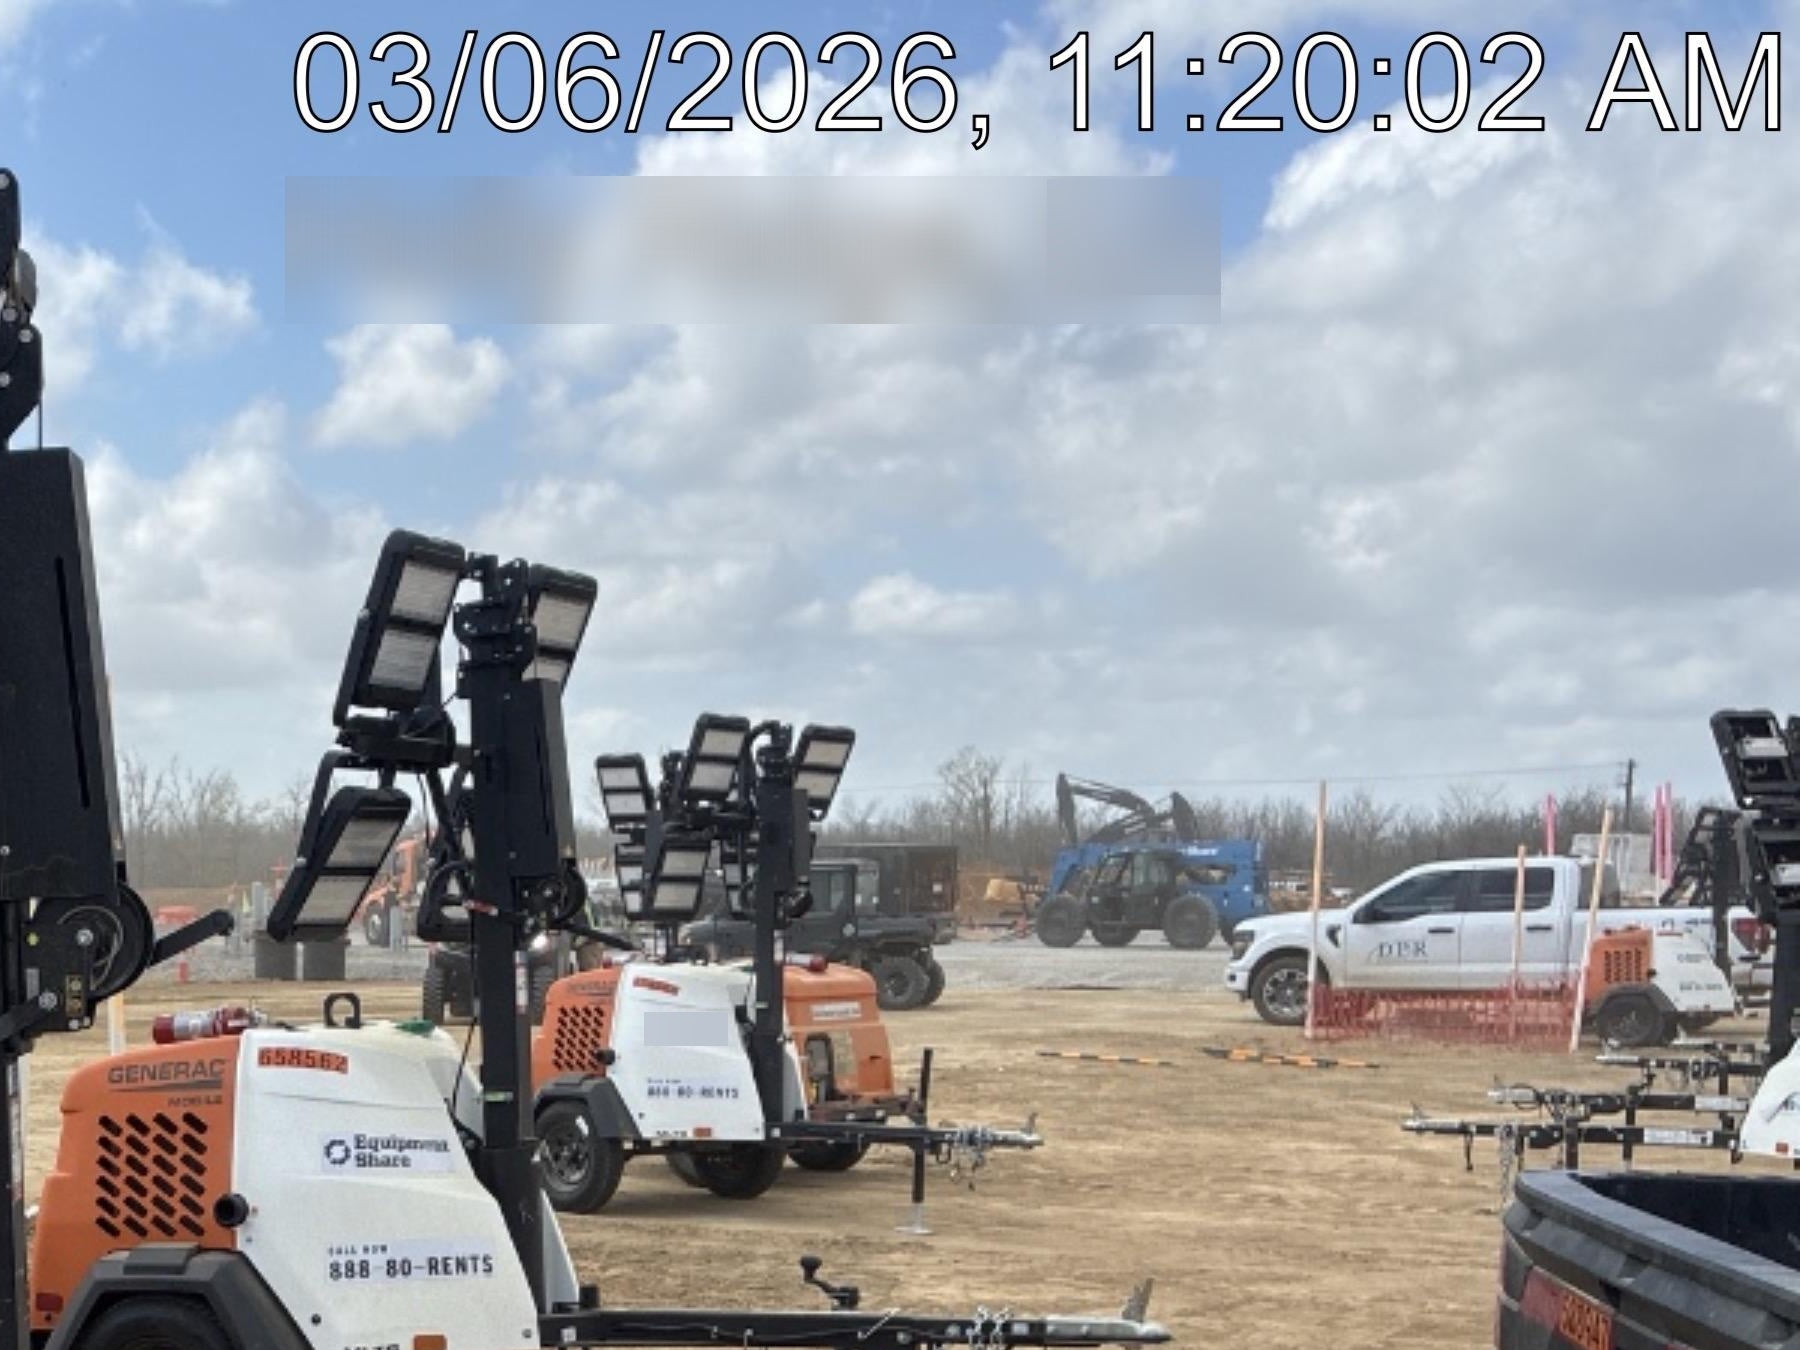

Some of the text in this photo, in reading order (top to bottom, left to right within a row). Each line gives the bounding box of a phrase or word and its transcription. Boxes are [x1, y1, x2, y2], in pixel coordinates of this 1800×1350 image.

[107, 1058, 226, 1084] GENERAC
[259, 1047, 347, 1073] 658562
[354, 1134, 449, 1153] Equipment
[356, 1152, 412, 1168] Share
[328, 1254, 494, 1281] 888-80-RENTS
